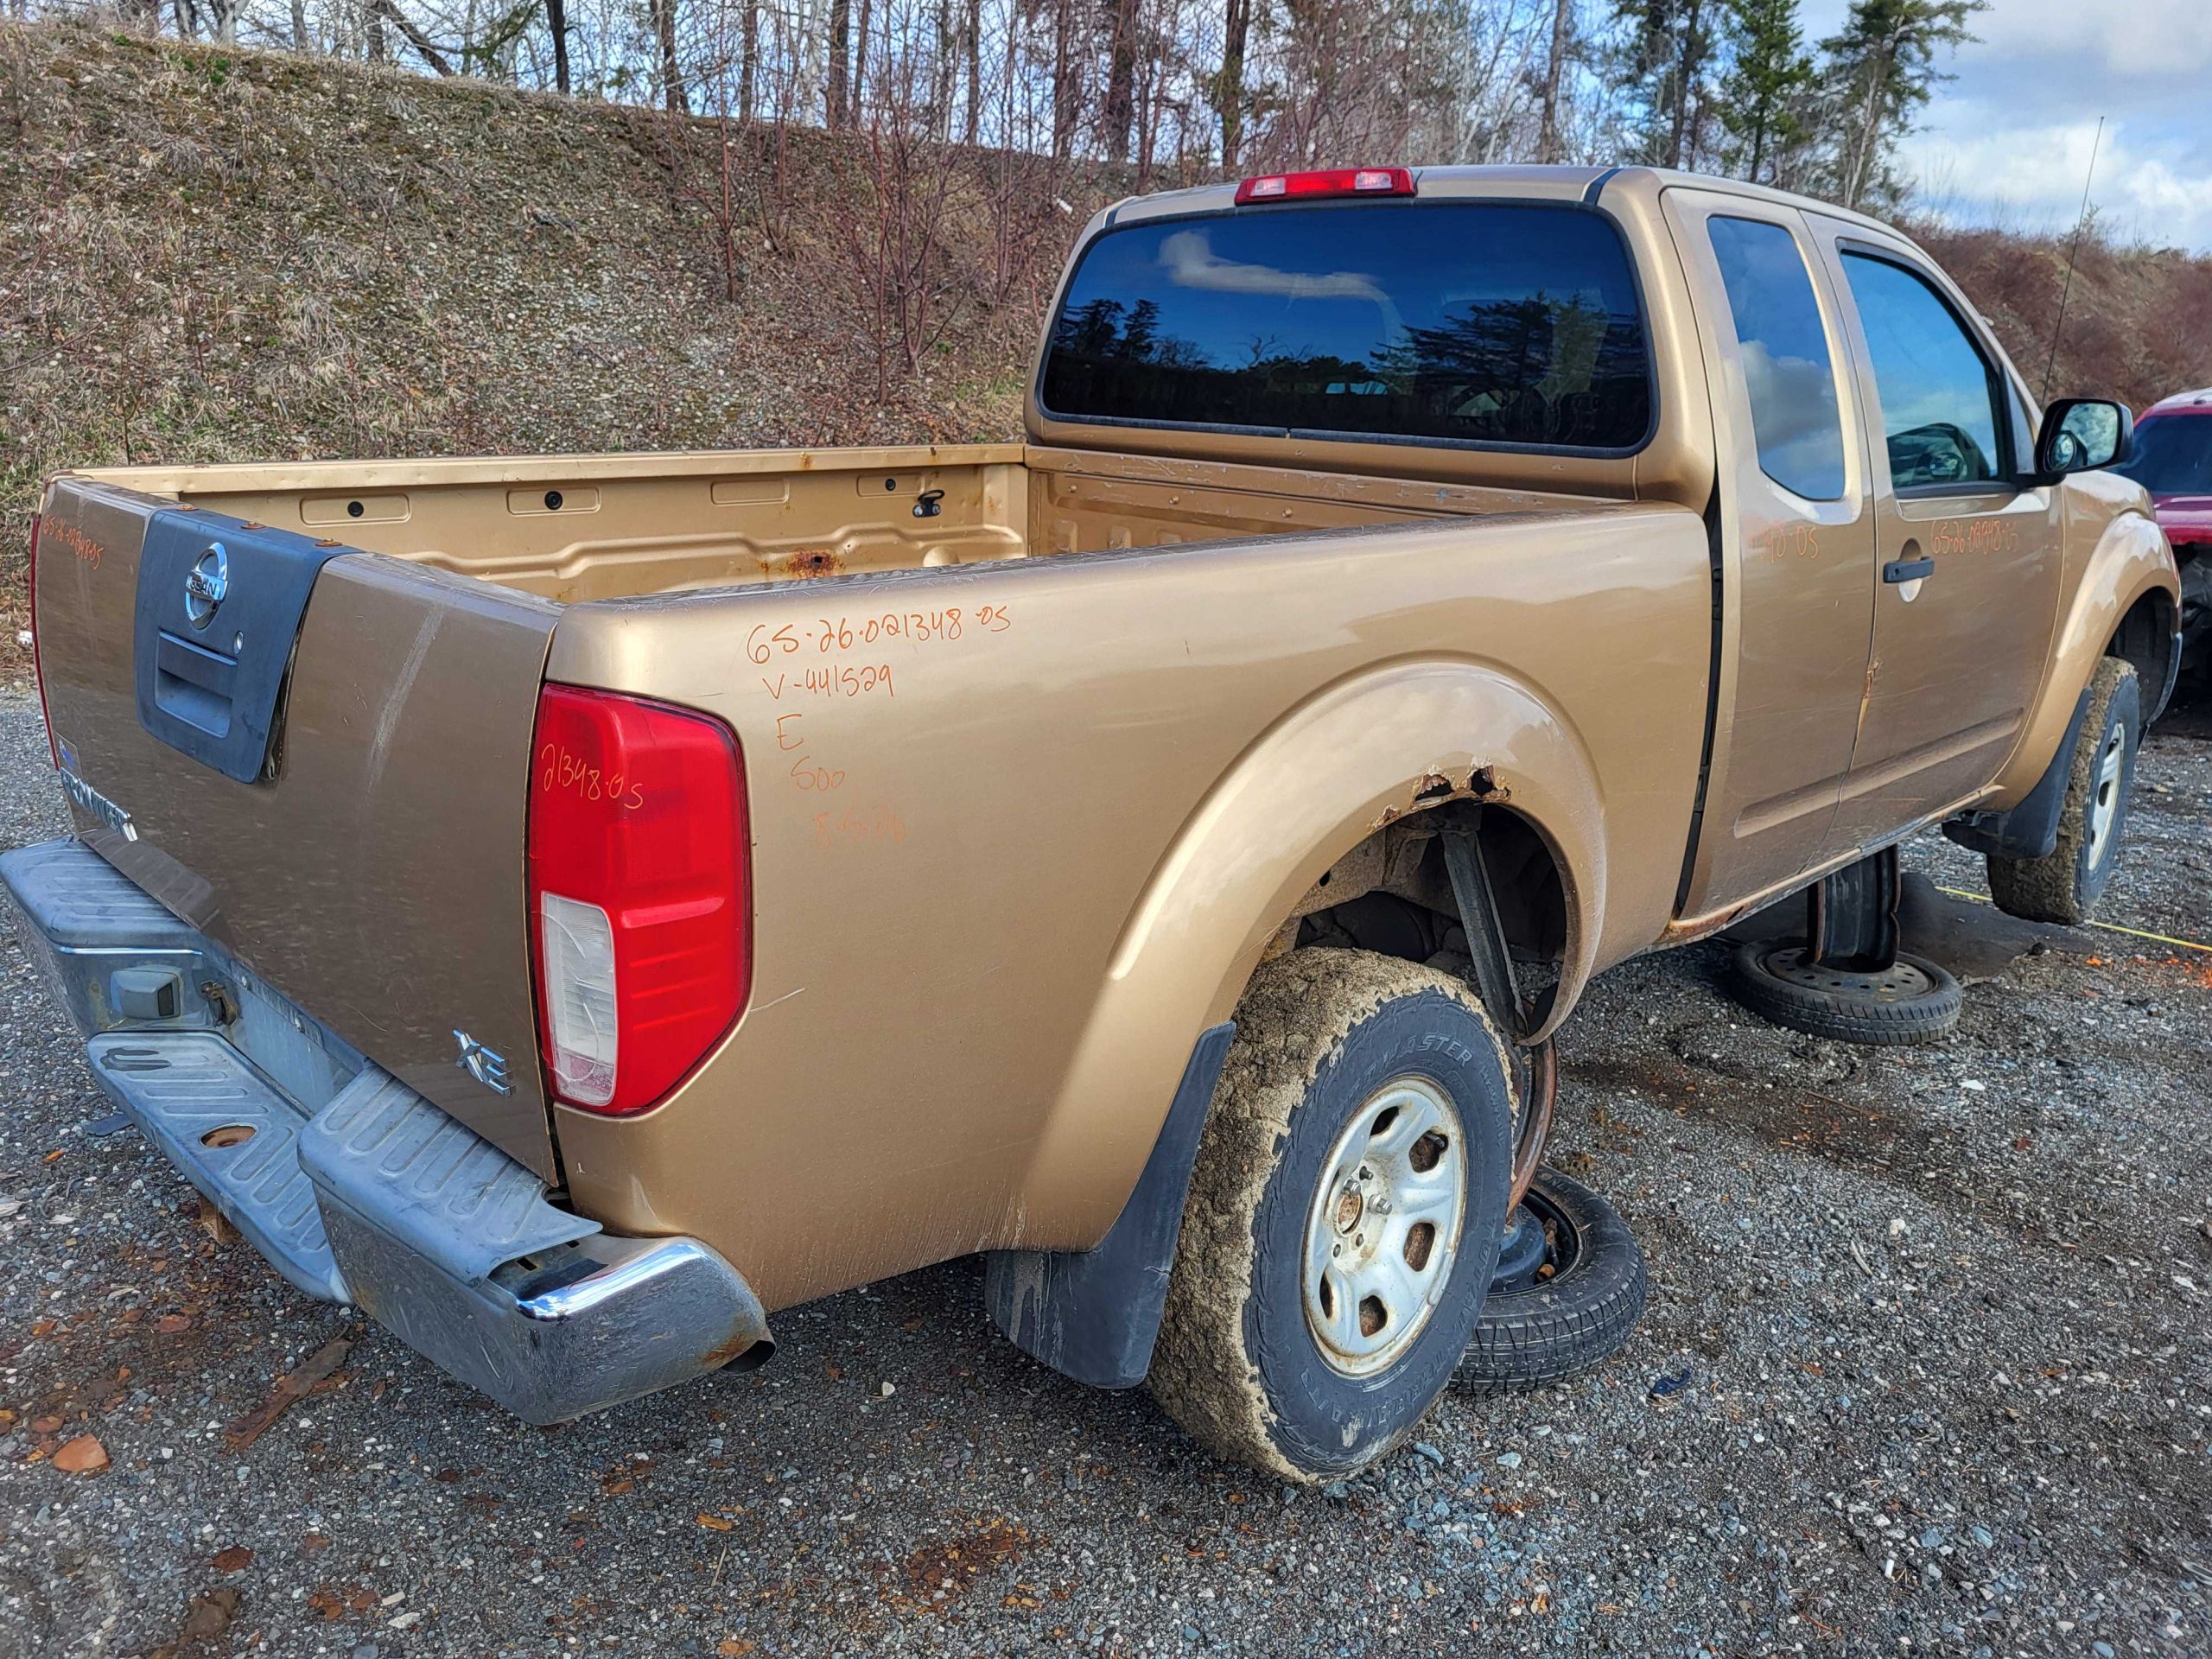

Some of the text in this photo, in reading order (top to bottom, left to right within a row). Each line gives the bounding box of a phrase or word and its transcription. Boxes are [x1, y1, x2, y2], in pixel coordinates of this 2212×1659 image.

[185, 574, 219, 596] NISSAN
[777, 713, 804, 751] E
[452, 1029, 516, 1098] XE
